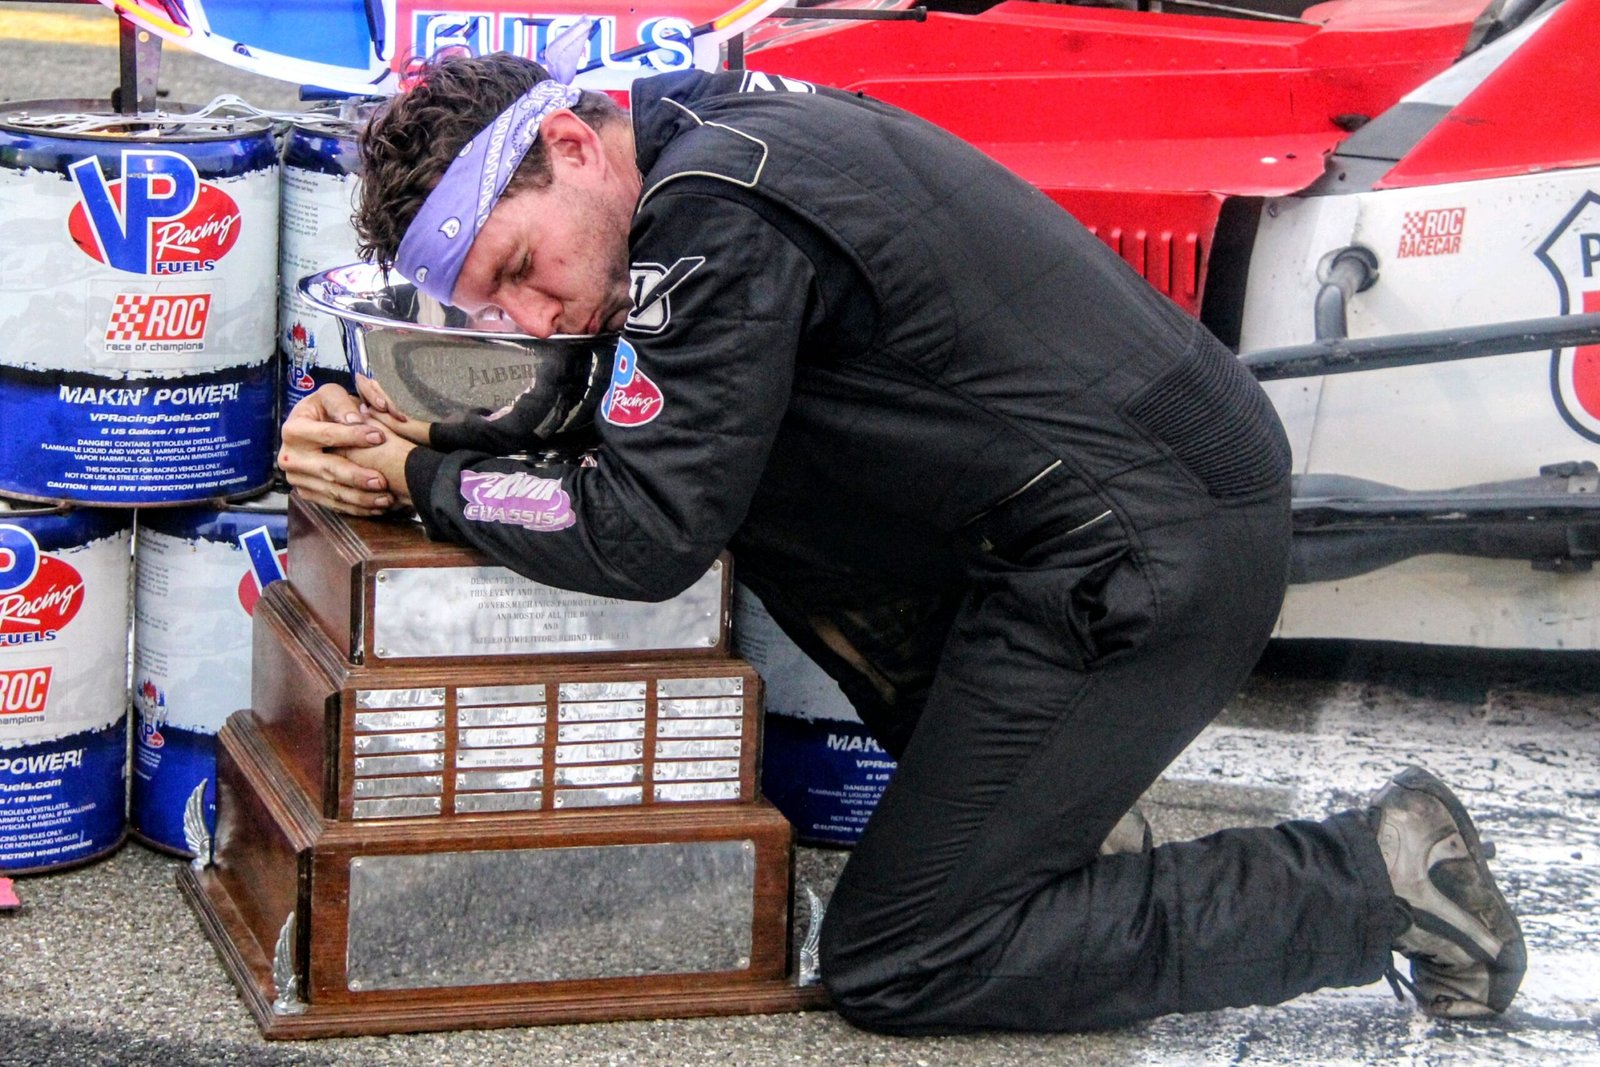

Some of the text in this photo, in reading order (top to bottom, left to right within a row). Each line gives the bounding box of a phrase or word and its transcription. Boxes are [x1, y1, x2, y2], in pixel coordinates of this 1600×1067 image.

[69, 150, 199, 275] VP
[1424, 210, 1462, 236] ROC
[156, 213, 240, 260] Racing
[1397, 237, 1461, 258] RACECAR
[156, 260, 215, 273] FUELS
[145, 297, 205, 337] ROC
[106, 342, 204, 352] race of champions
[59, 382, 240, 407] MAKIN' POWER!
[611, 389, 661, 415] Racing
[90, 411, 220, 424] VPRacingFuels.com
[128, 427, 166, 435] Gallons
[188, 425, 211, 434] liters
[77, 438, 113, 447] DANGER!
[152, 439, 192, 447] PETROLEUM
[41, 443, 82, 453] FLAMMABLE
[153, 447, 186, 455] HARMFUL
[196, 444, 214, 452] FATAL
[74, 453, 98, 462] VAPOR
[136, 455, 154, 463] CALL
[155, 453, 191, 462] PHYSICIAN
[85, 465, 100, 473] THIS
[100, 466, 132, 474] PRODUCT
[178, 463, 205, 472] VEHICLES
[175, 470, 213, 480] NON-RACING
[47, 480, 89, 490] CAUTION:
[90, 484, 117, 492] WEAR
[137, 483, 194, 492] PROTECTION
[195, 480, 219, 489] WHEN
[0, 582, 84, 627] Racing
[0, 630, 57, 645] FUELS
[0, 715, 45, 726] ampions
[0, 749, 83, 775] POWER!
[28, 793, 52, 803] liters
[0, 815, 25, 824] ARMFUL
[26, 814, 37, 822] OR
[0, 822, 31, 832] HYSICIAN
[18, 831, 46, 841] VEHICLES
[36, 846, 61, 857] WHEN
